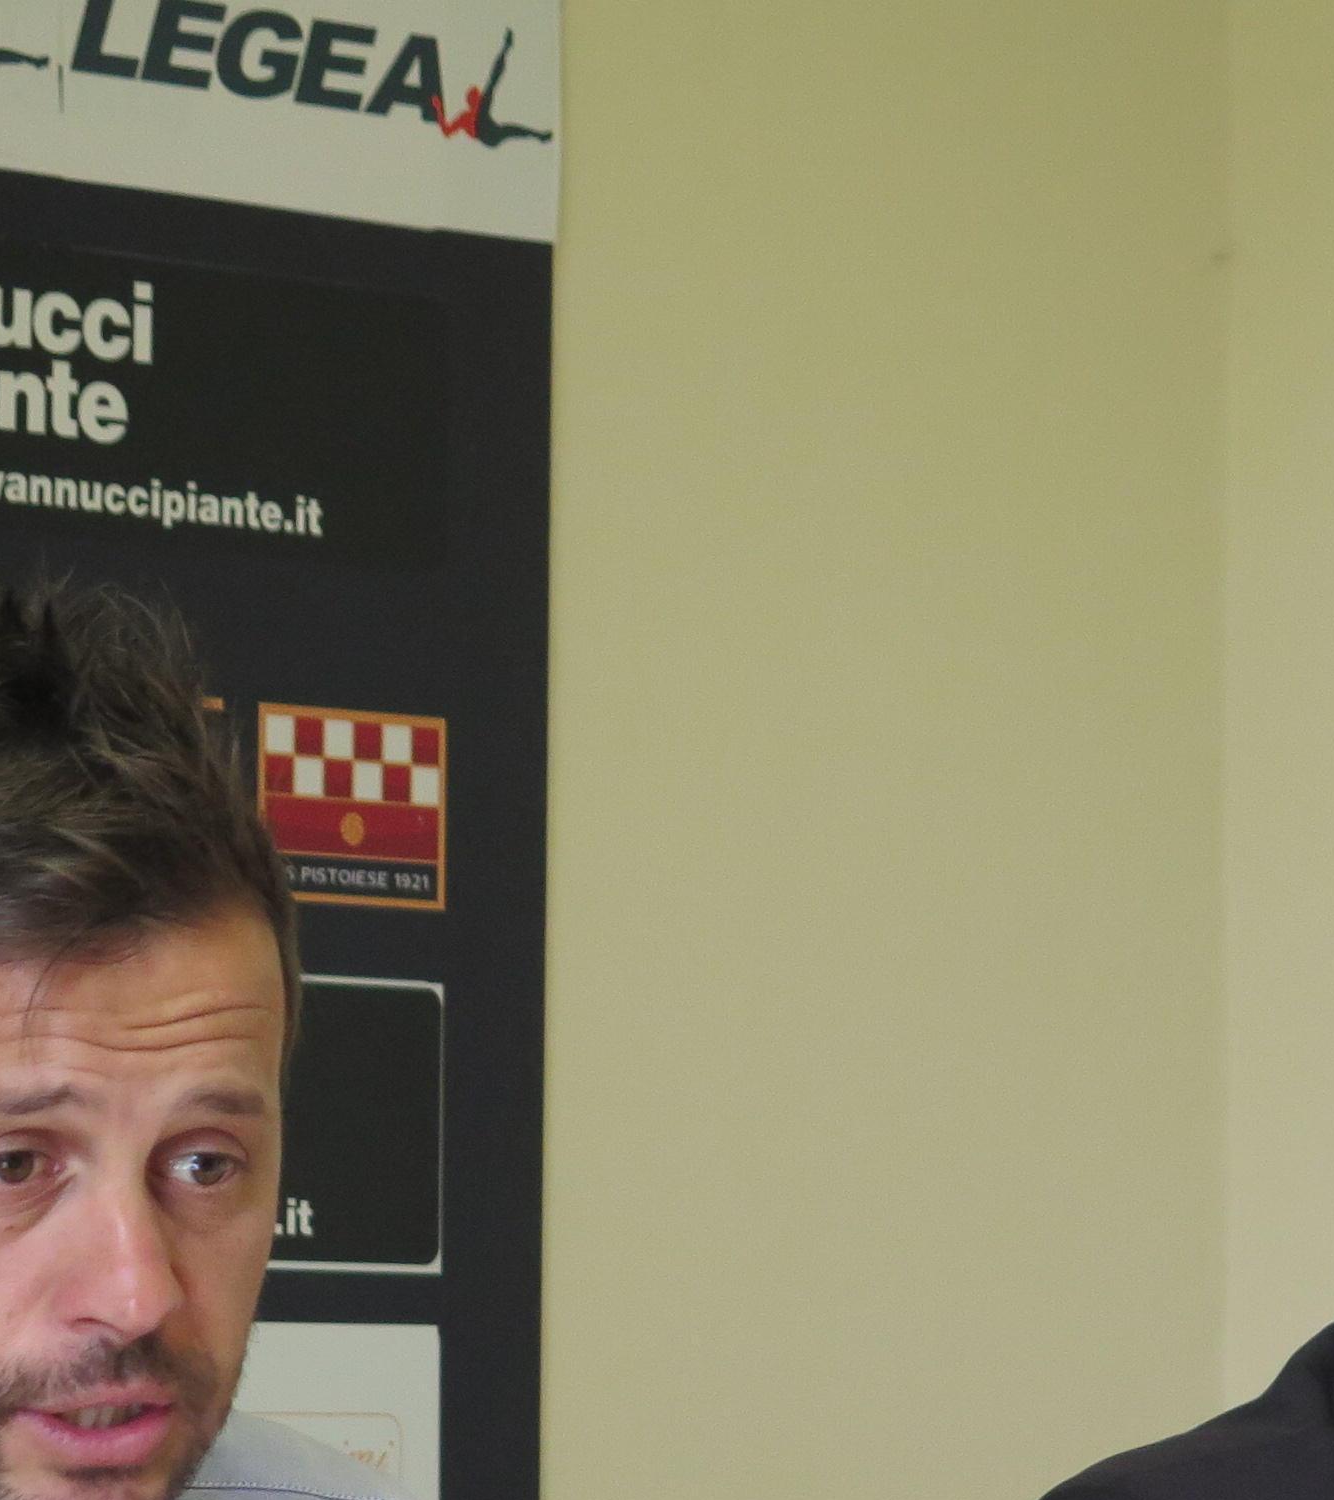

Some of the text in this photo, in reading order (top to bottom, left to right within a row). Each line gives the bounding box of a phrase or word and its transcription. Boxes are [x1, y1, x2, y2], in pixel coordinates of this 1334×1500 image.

[70, 0, 445, 123] LEGEA
[300, 866, 388, 887] PISTOIESE
[393, 872, 430, 891] 1921
